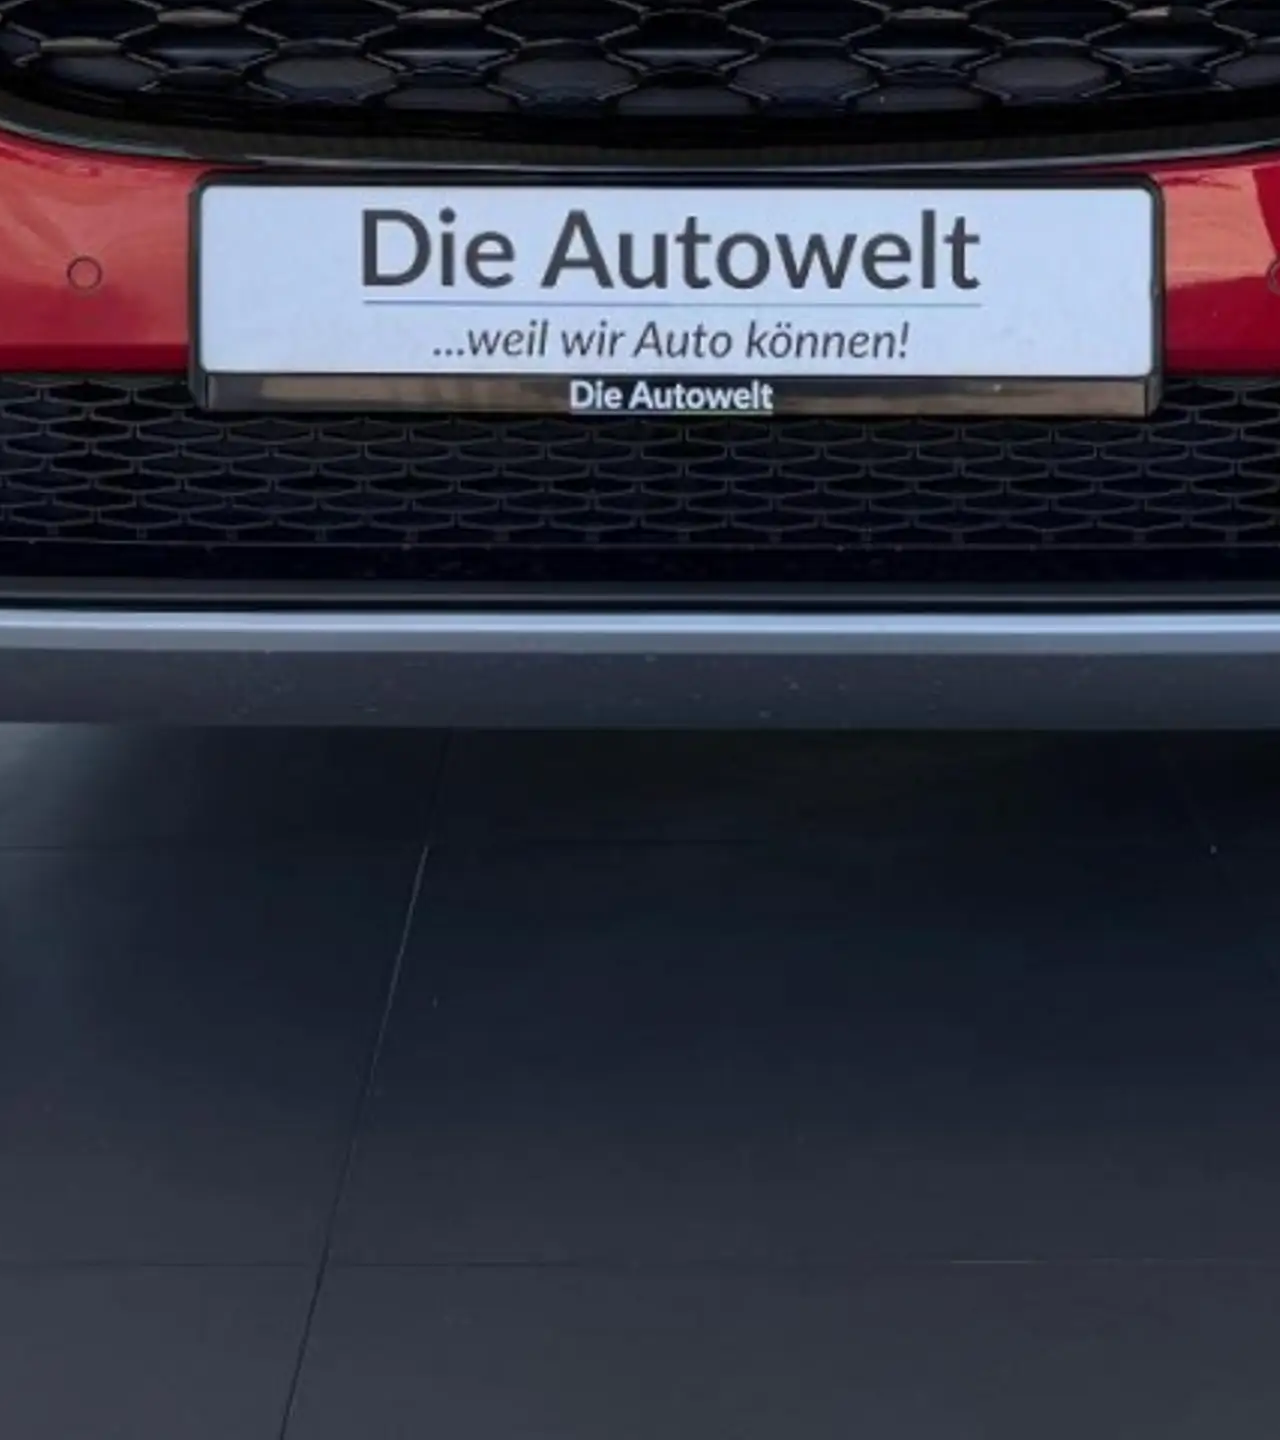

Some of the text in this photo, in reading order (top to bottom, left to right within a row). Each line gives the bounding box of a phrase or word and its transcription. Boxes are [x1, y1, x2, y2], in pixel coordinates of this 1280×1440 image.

[362, 207, 981, 290] Die Autowelt
[432, 318, 910, 359] ...weil wir Auto können!
[570, 380, 773, 410] Die Autowelt
